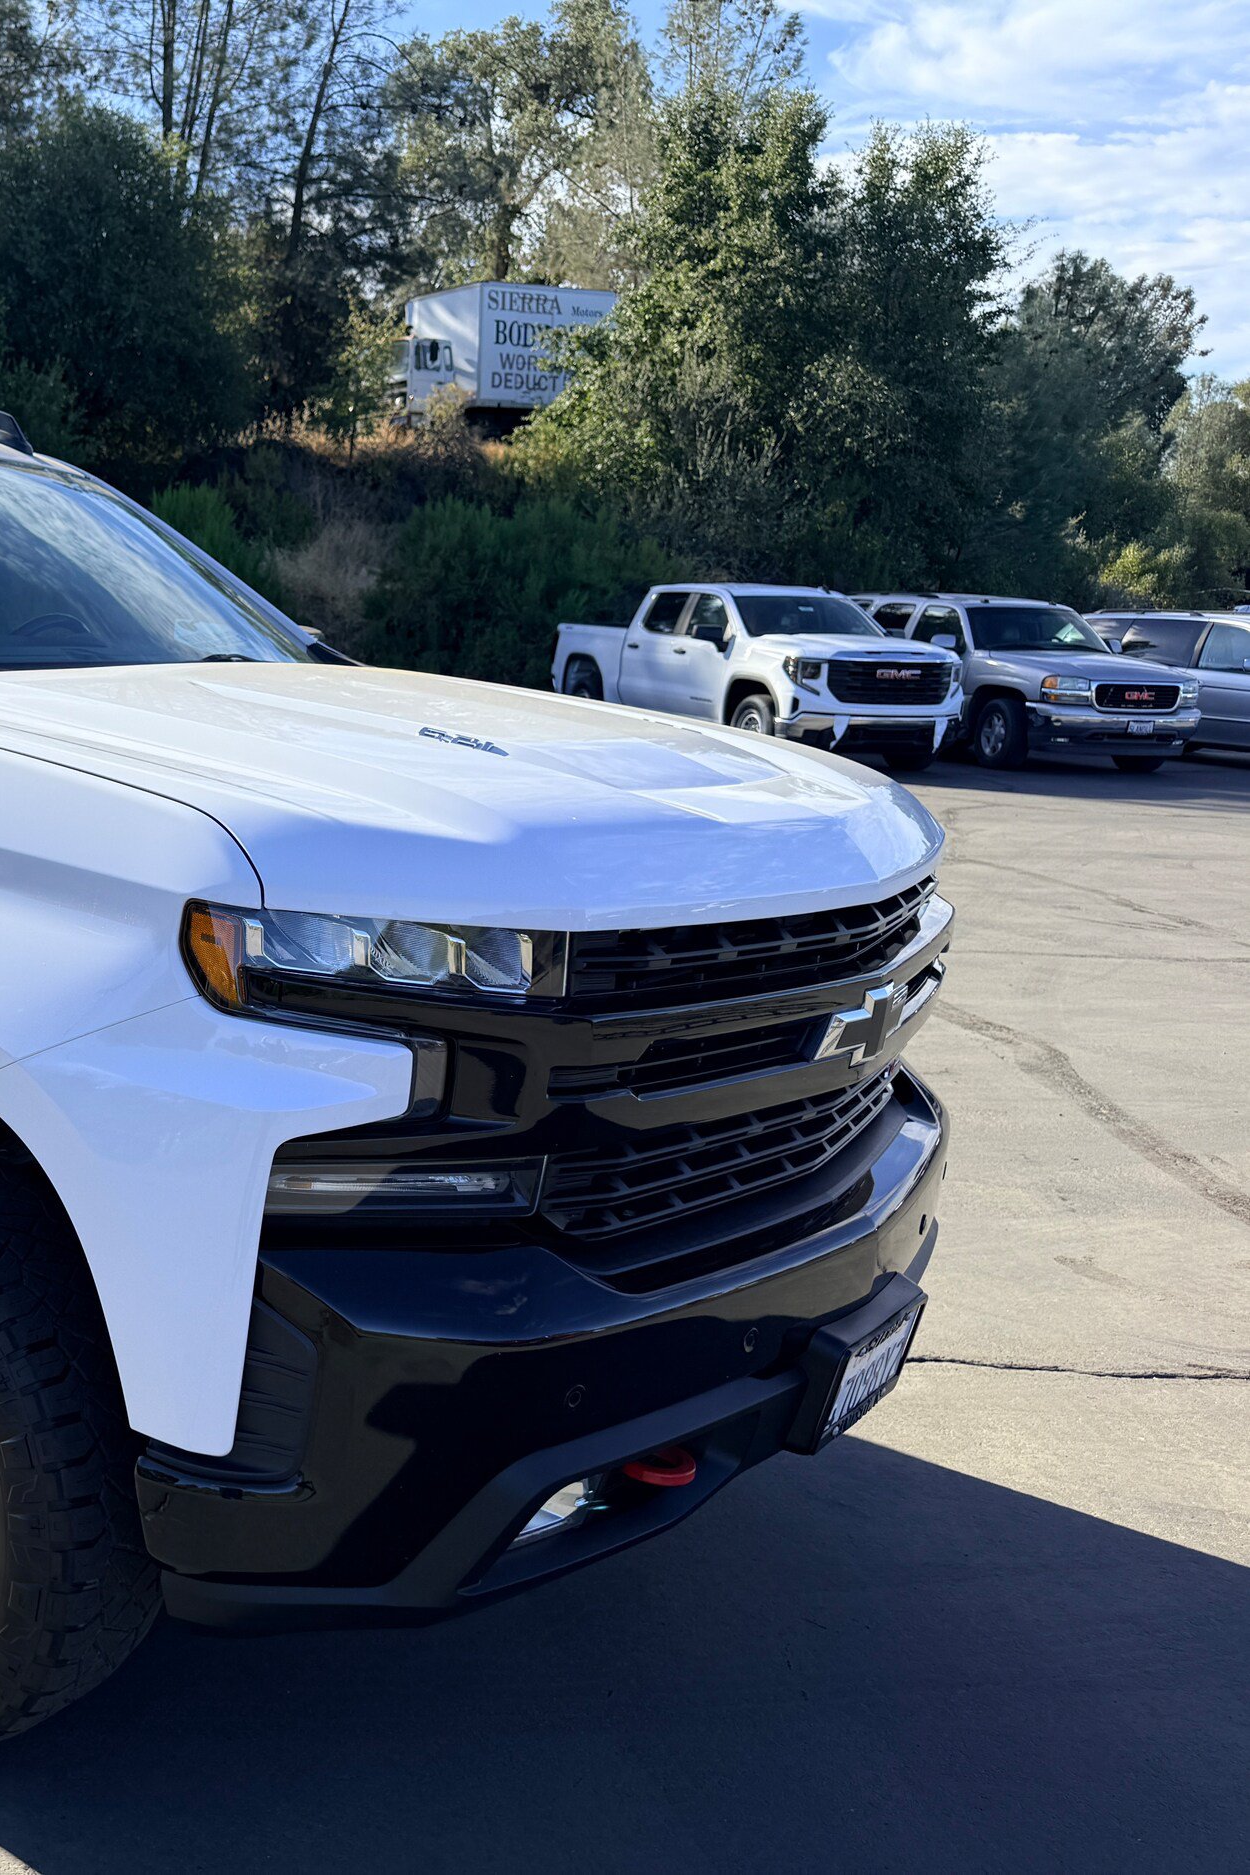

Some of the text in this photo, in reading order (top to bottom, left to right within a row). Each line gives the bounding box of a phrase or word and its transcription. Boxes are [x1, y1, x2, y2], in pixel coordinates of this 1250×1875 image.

[488, 290, 562, 315] SIERRA
[876, 669, 921, 680] GMC
[1125, 691, 1155, 700] GMC
